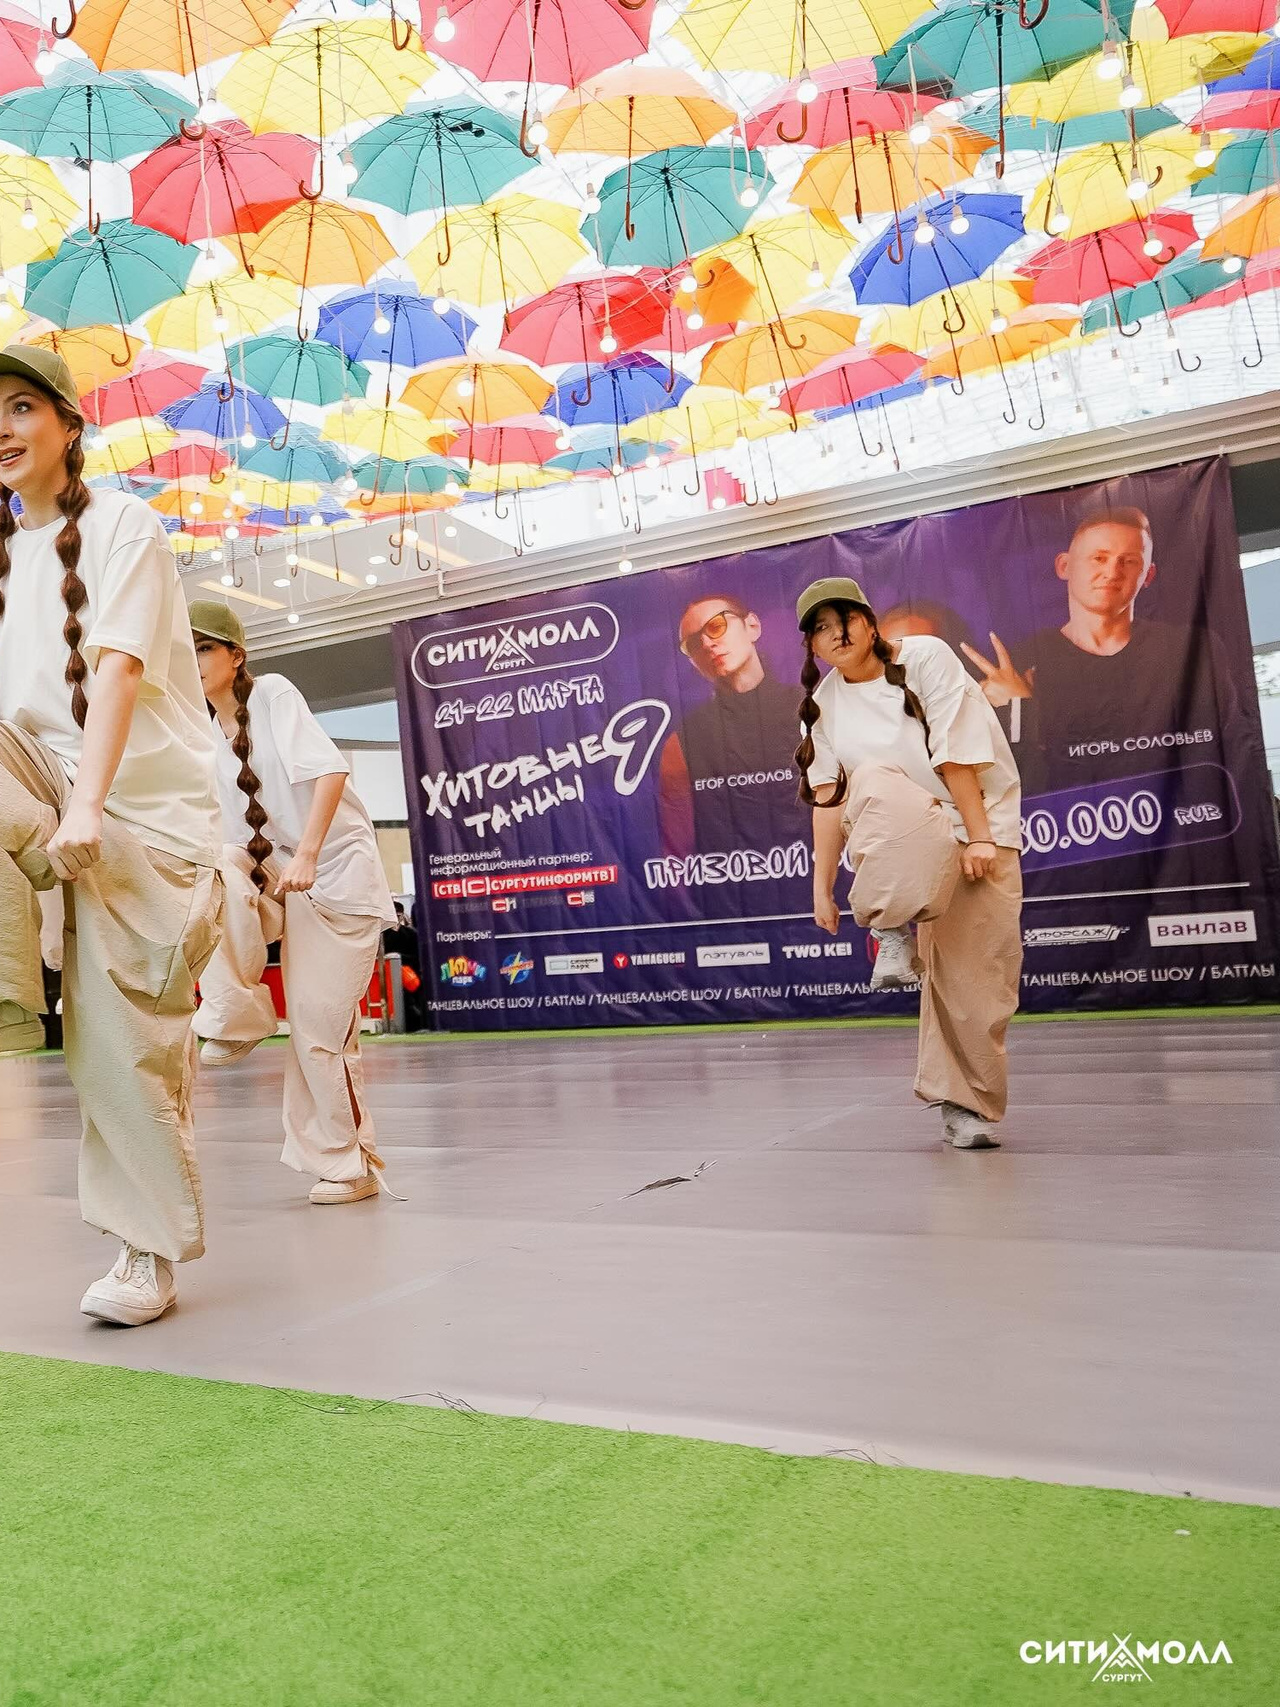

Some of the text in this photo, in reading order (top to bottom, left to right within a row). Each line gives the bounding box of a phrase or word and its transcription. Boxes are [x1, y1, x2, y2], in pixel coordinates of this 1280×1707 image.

[492, 658, 526, 671] СУРГУТ
[434, 674, 605, 728] 21-22 МАРТА
[1068, 728, 1214, 758] ИГОРЬ СОЛОВЬЕВ
[420, 733, 608, 819] ХИТОВЫЕ
[694, 768, 793, 791] ЕГОР СОКОЛОВ
[463, 774, 585, 838] ТАНЦЫ
[1174, 803, 1223, 826] RUB
[429, 847, 502, 865] Генеральный
[430, 852, 594, 877] информационный партнер:
[644, 839, 809, 889] ПРИЗОВОЙ
[436, 930, 493, 943] Партнеры:
[1156, 920, 1248, 937] ванлав
[630, 951, 686, 966] YAMAGUCHI
[782, 942, 852, 959] TWO KEI
[1021, 969, 1147, 987] ТАНЦЕВАЛЬНОЕ
[1152, 967, 1194, 982] ШОУ
[1211, 964, 1276, 979] БАТТЛЫ
[428, 997, 505, 1011] ТАНЦЕВАЛЬНОЕ
[507, 996, 535, 1009] ШОУ
[545, 994, 586, 1007] БАТТЛЫ
[595, 989, 688, 1005] ТАНЦЕВАЛЬНОЕ
[691, 989, 722, 1002] ШОУ
[734, 986, 782, 999] БАТТЛЫ
[792, 982, 900, 997] ТАНЦЕВАЛЬ
